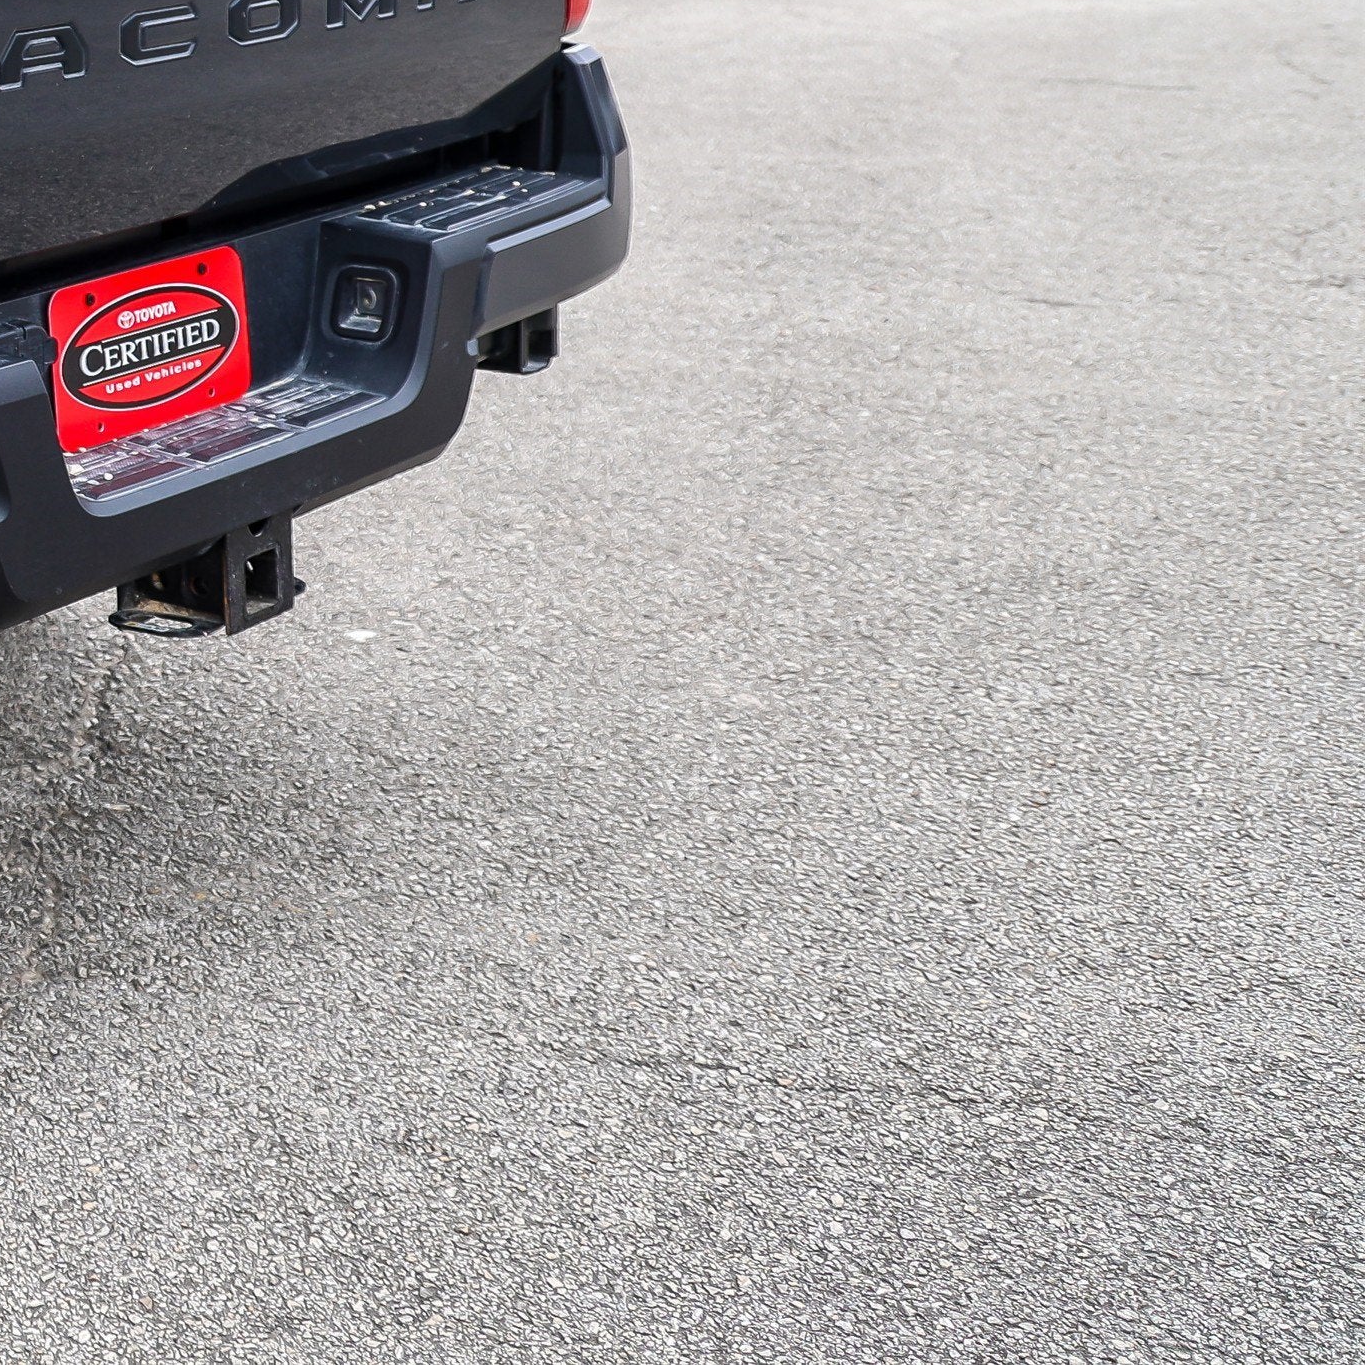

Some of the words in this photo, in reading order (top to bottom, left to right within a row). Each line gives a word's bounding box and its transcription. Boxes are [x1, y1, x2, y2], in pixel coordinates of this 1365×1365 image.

[134, 300, 177, 325] TOYOTA
[79, 318, 222, 377] CERTIFIED
[105, 376, 141, 395] Used
[144, 358, 203, 383] Vehicles
